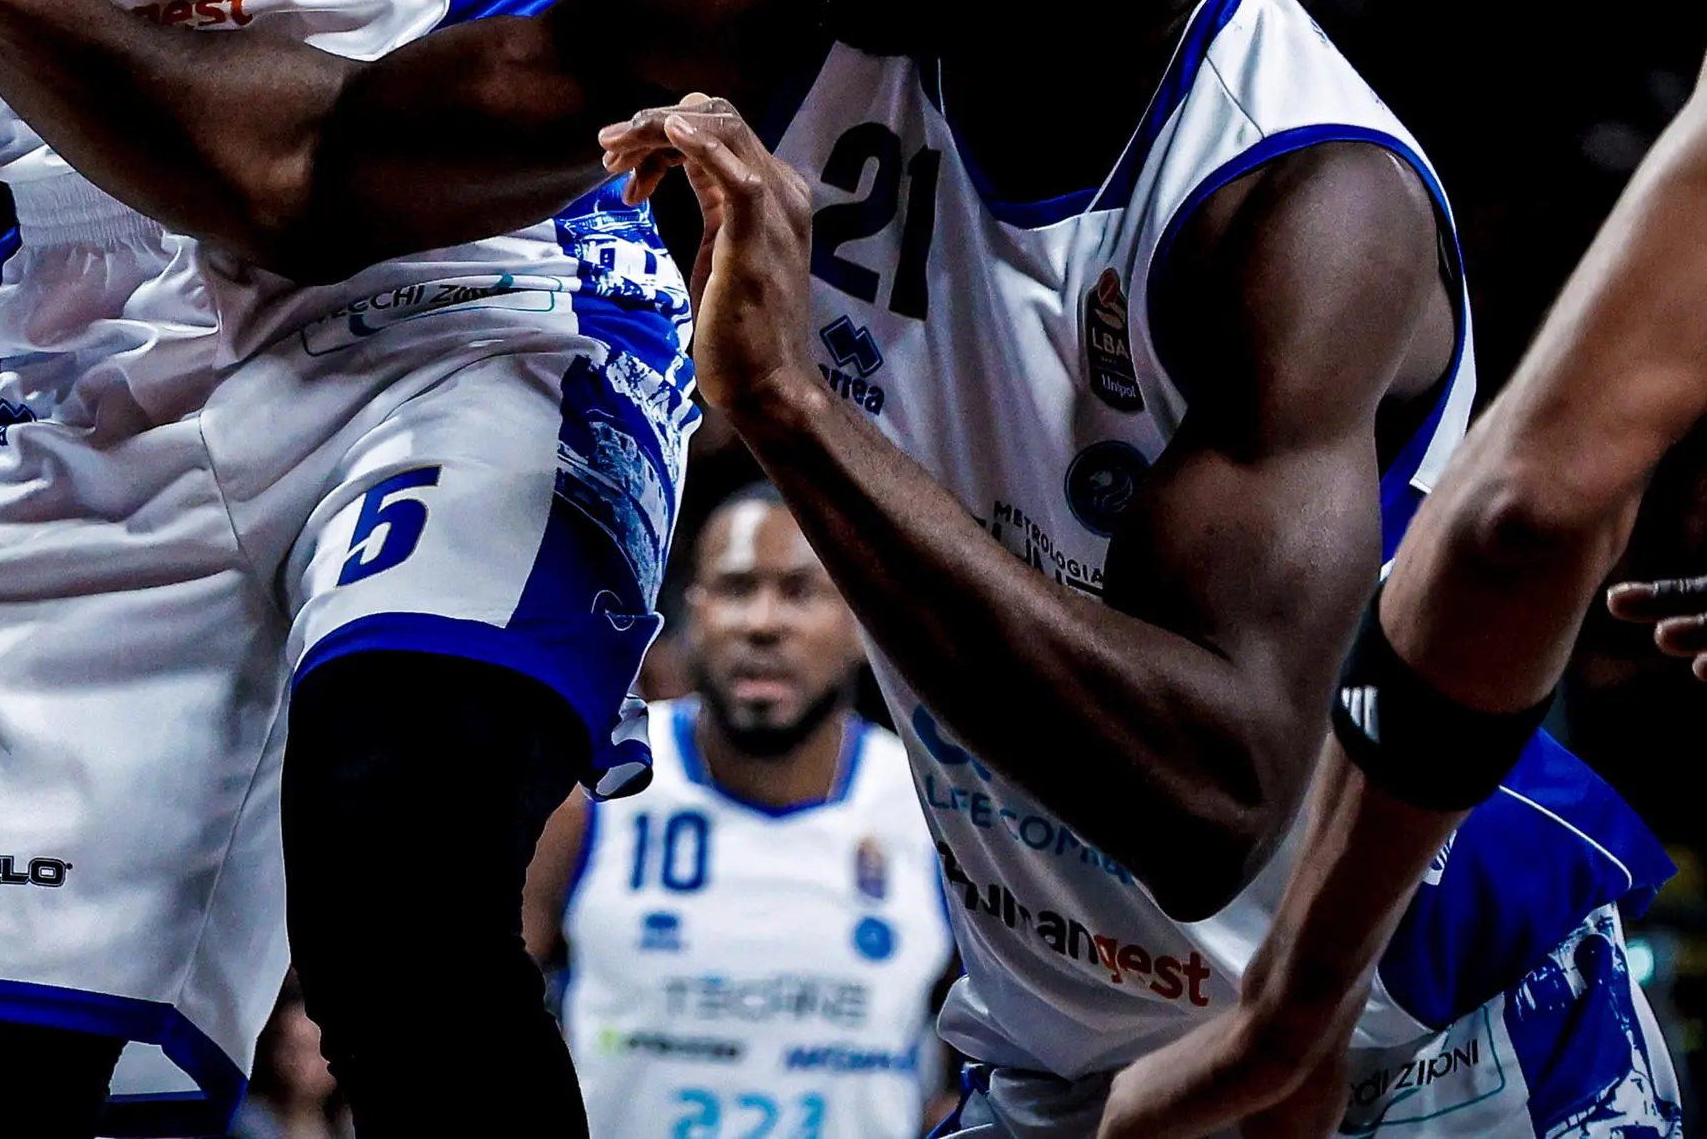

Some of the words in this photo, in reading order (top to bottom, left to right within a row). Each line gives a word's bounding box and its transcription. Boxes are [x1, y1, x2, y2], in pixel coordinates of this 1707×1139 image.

[809, 122, 942, 321] 21
[1091, 326, 1130, 359] LBA
[1101, 373, 1137, 400] Unipol
[336, 466, 440, 587] 5
[994, 500, 1104, 583] METROLOGIA
[629, 809, 711, 893] 10
